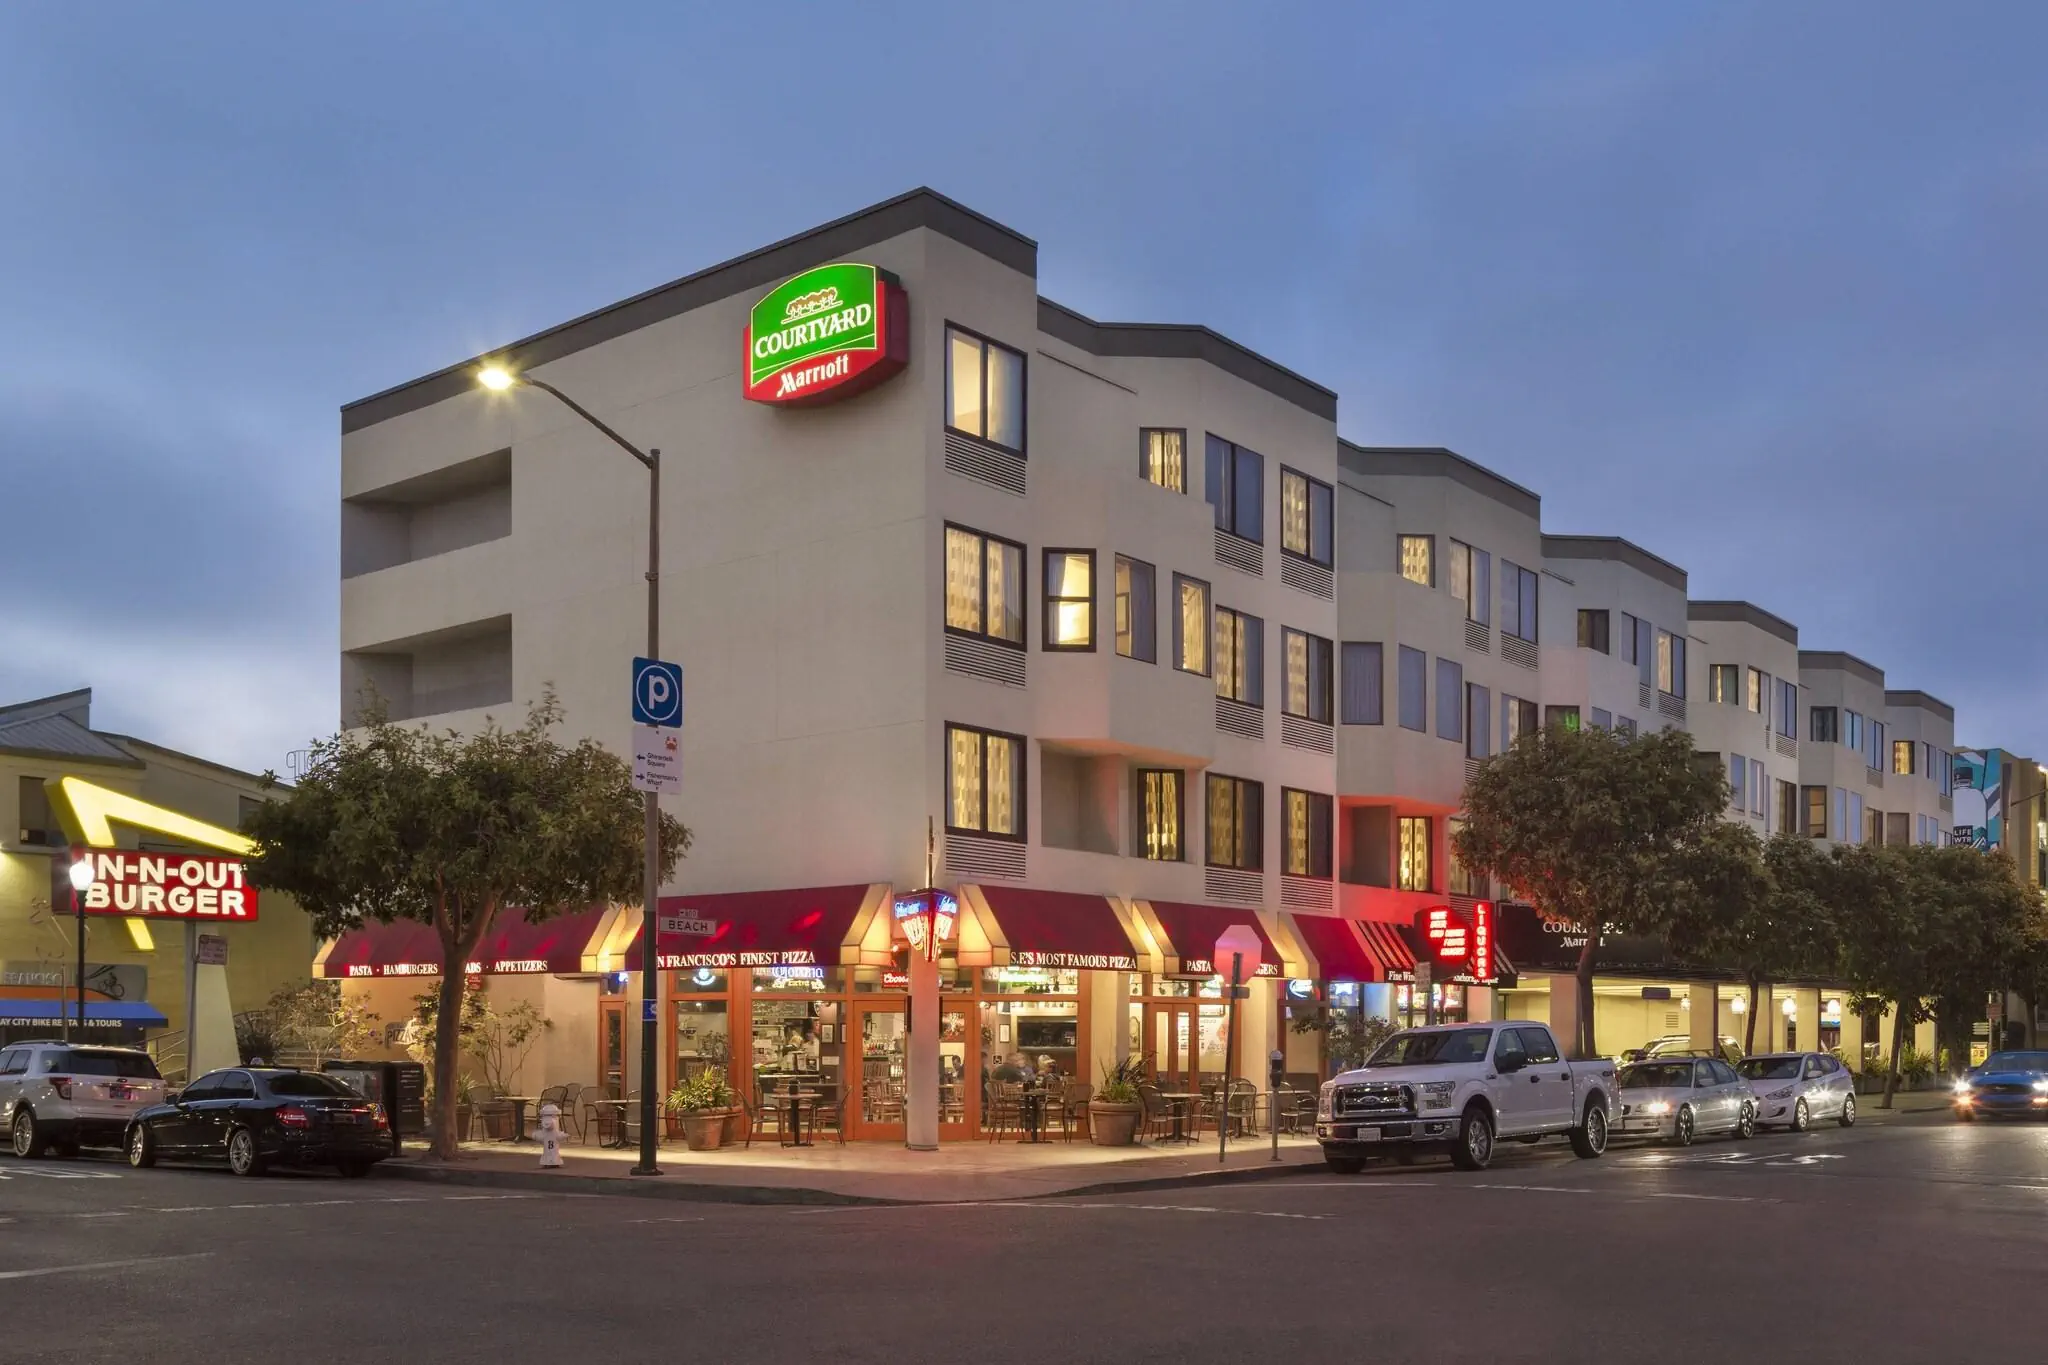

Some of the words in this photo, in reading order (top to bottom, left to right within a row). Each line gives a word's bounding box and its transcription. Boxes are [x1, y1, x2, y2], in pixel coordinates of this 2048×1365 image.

[755, 303, 872, 358] COURTYARD
[776, 353, 849, 397] Marriott
[1953, 828, 1971, 836] LIFE
[84, 853, 244, 889] IN-N-OUT
[84, 882, 246, 916] BURGER
[668, 919, 708, 932] BEACH
[1476, 904, 1487, 977] LIQUORS
[667, 954, 736, 968] FRANCISCO'S
[740, 952, 779, 966] FINEST
[781, 951, 815, 965] PIZZA
[1036, 953, 1066, 966] MOST
[1067, 955, 1107, 968] FAMOUS
[1109, 956, 1136, 969] PIZZA
[1186, 960, 1212, 972] PASTA
[350, 965, 372, 977] PASTA
[383, 963, 438, 976] HAMBURGERS
[494, 960, 548, 973] APPETIZERS
[1388, 970, 1402, 981] Fine
[12, 1018, 30, 1027] CITY
[32, 1018, 50, 1027] BIKE
[89, 1019, 95, 1027] &
[95, 1019, 122, 1028] TOURS
